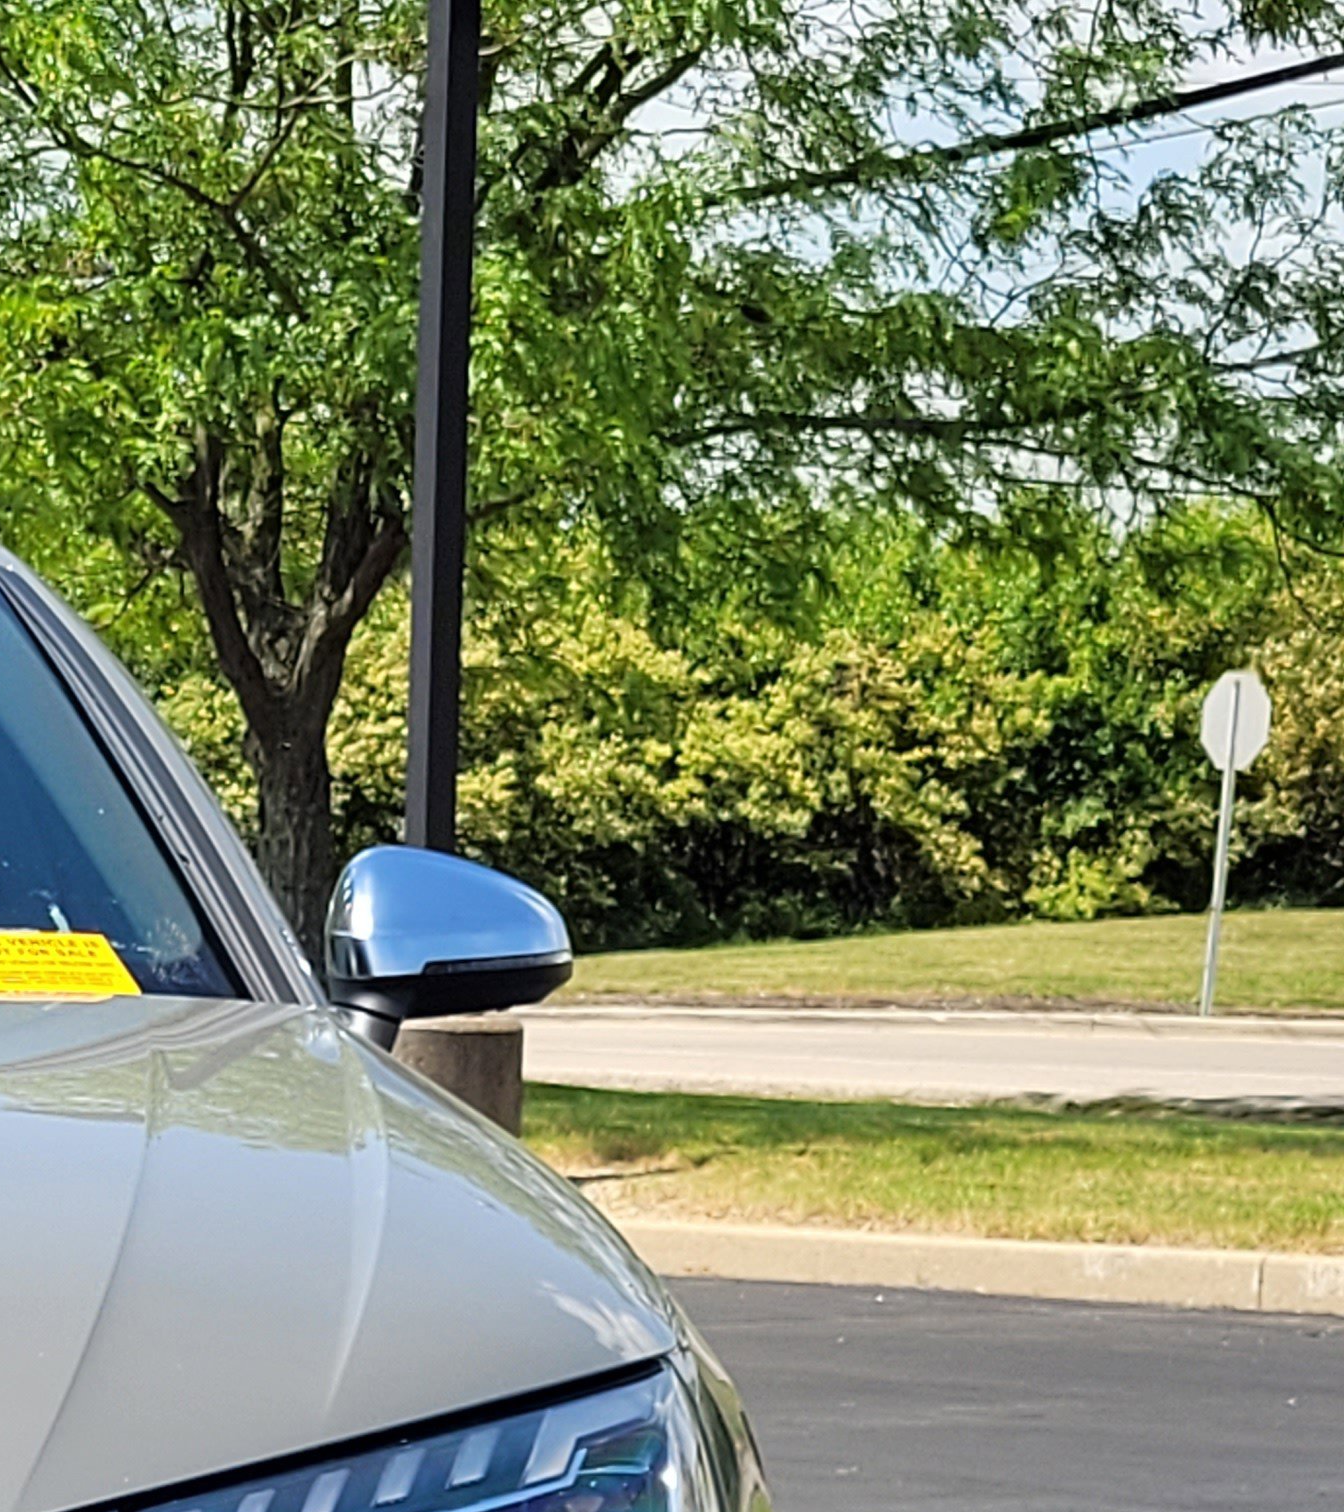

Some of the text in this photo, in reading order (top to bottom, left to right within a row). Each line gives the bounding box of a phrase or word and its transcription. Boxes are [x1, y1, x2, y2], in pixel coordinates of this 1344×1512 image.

[6, 938, 78, 948] VEHICLE
[84, 939, 100, 948] IS
[17, 948, 50, 956] FOR
[55, 949, 98, 958] SALE
